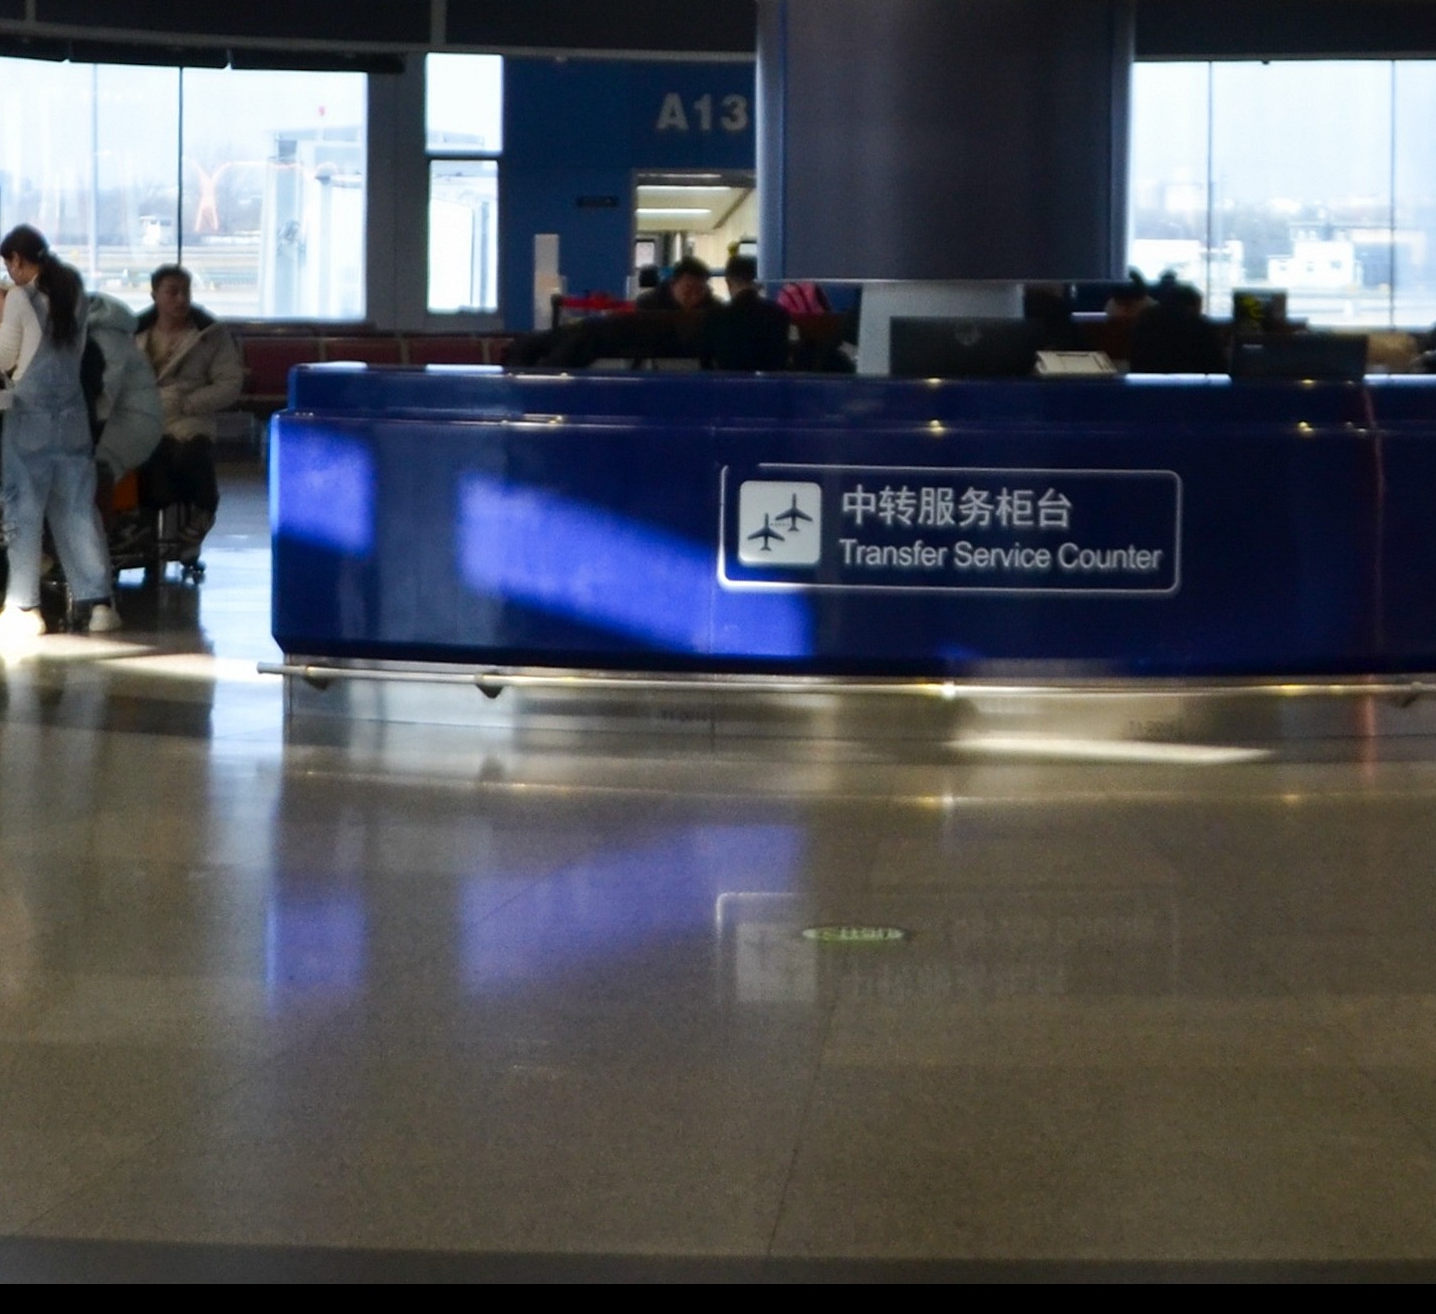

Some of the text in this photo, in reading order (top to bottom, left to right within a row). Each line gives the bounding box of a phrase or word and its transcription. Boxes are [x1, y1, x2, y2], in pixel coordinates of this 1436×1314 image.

[656, 92, 750, 132] A13
[842, 485, 1072, 530] 中转服务柜台
[840, 539, 1162, 571] Transfer Service Counter
